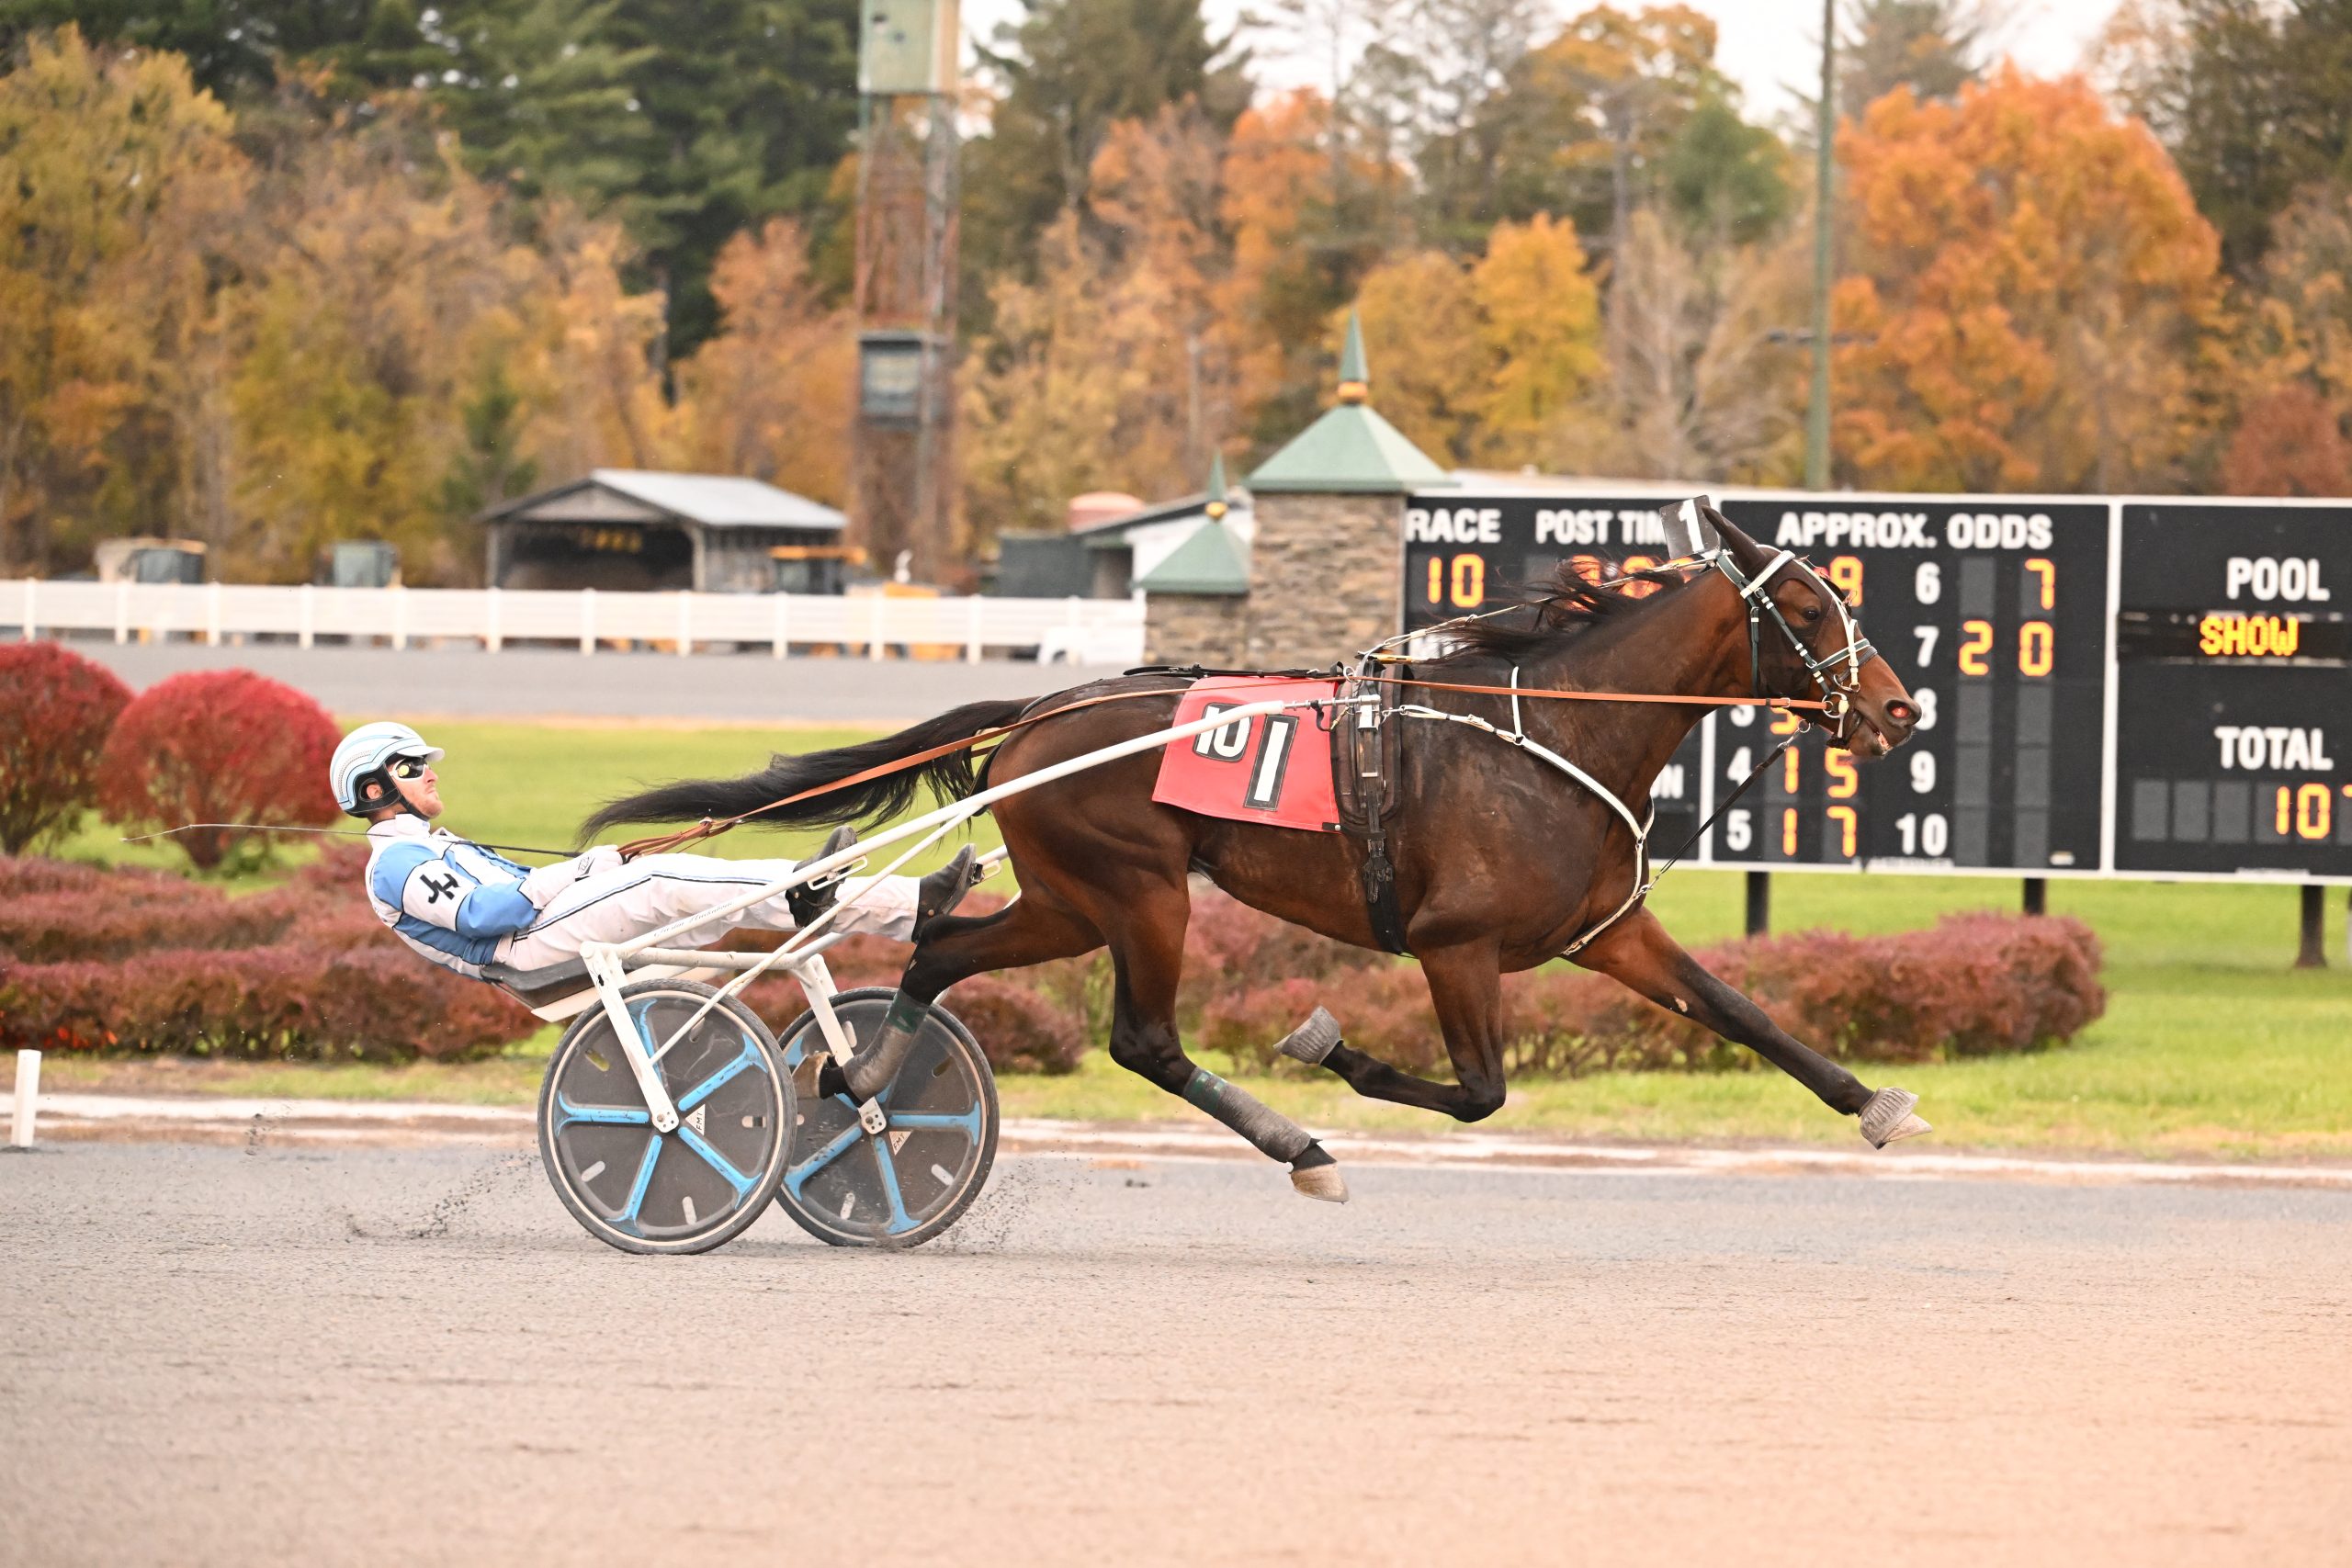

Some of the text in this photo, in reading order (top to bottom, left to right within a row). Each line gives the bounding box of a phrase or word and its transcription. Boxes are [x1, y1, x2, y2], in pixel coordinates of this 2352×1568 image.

[1405, 509, 1501, 543] RACE
[1535, 509, 1668, 545] POST TIM
[1678, 499, 1705, 554] 1
[1775, 511, 2053, 550] APPROX. ODDS
[1427, 553, 1485, 608] 10
[1915, 558, 2056, 610] 6 7
[2226, 557, 2331, 602] POOL
[1913, 625, 1940, 668] 7
[2199, 615, 2299, 656] SHOW
[1251, 719, 1290, 804] 1
[1726, 746, 1752, 786] 4
[2213, 726, 2335, 771] TOTAL
[1910, 750, 1937, 794] 9
[1726, 808, 1752, 852] 5
[2276, 783, 2352, 840] 10
[1894, 812, 1948, 856] 10
